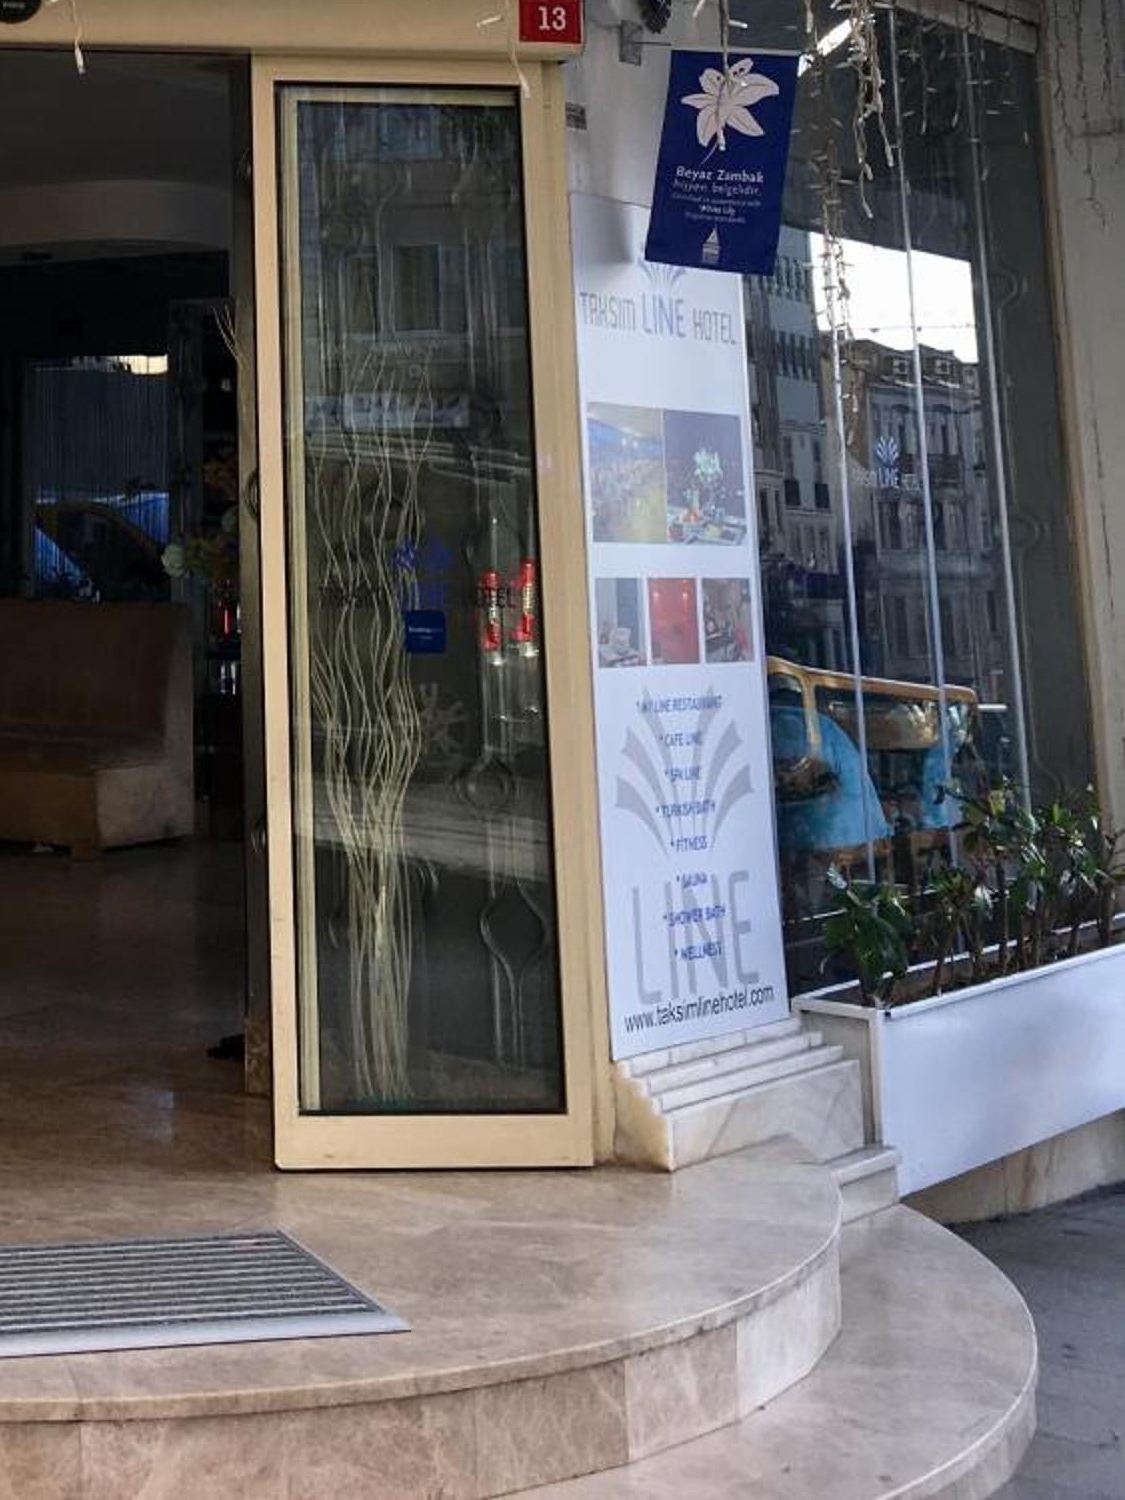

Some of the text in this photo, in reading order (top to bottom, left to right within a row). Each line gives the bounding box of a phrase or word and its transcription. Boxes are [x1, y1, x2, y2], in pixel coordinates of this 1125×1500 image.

[538, 5, 567, 31] 13
[716, 169, 764, 183] Zambak
[641, 292, 687, 339] LINE
[692, 307, 737, 345] HOTEL
[623, 985, 775, 1033] www.taksimlinehotel.com
